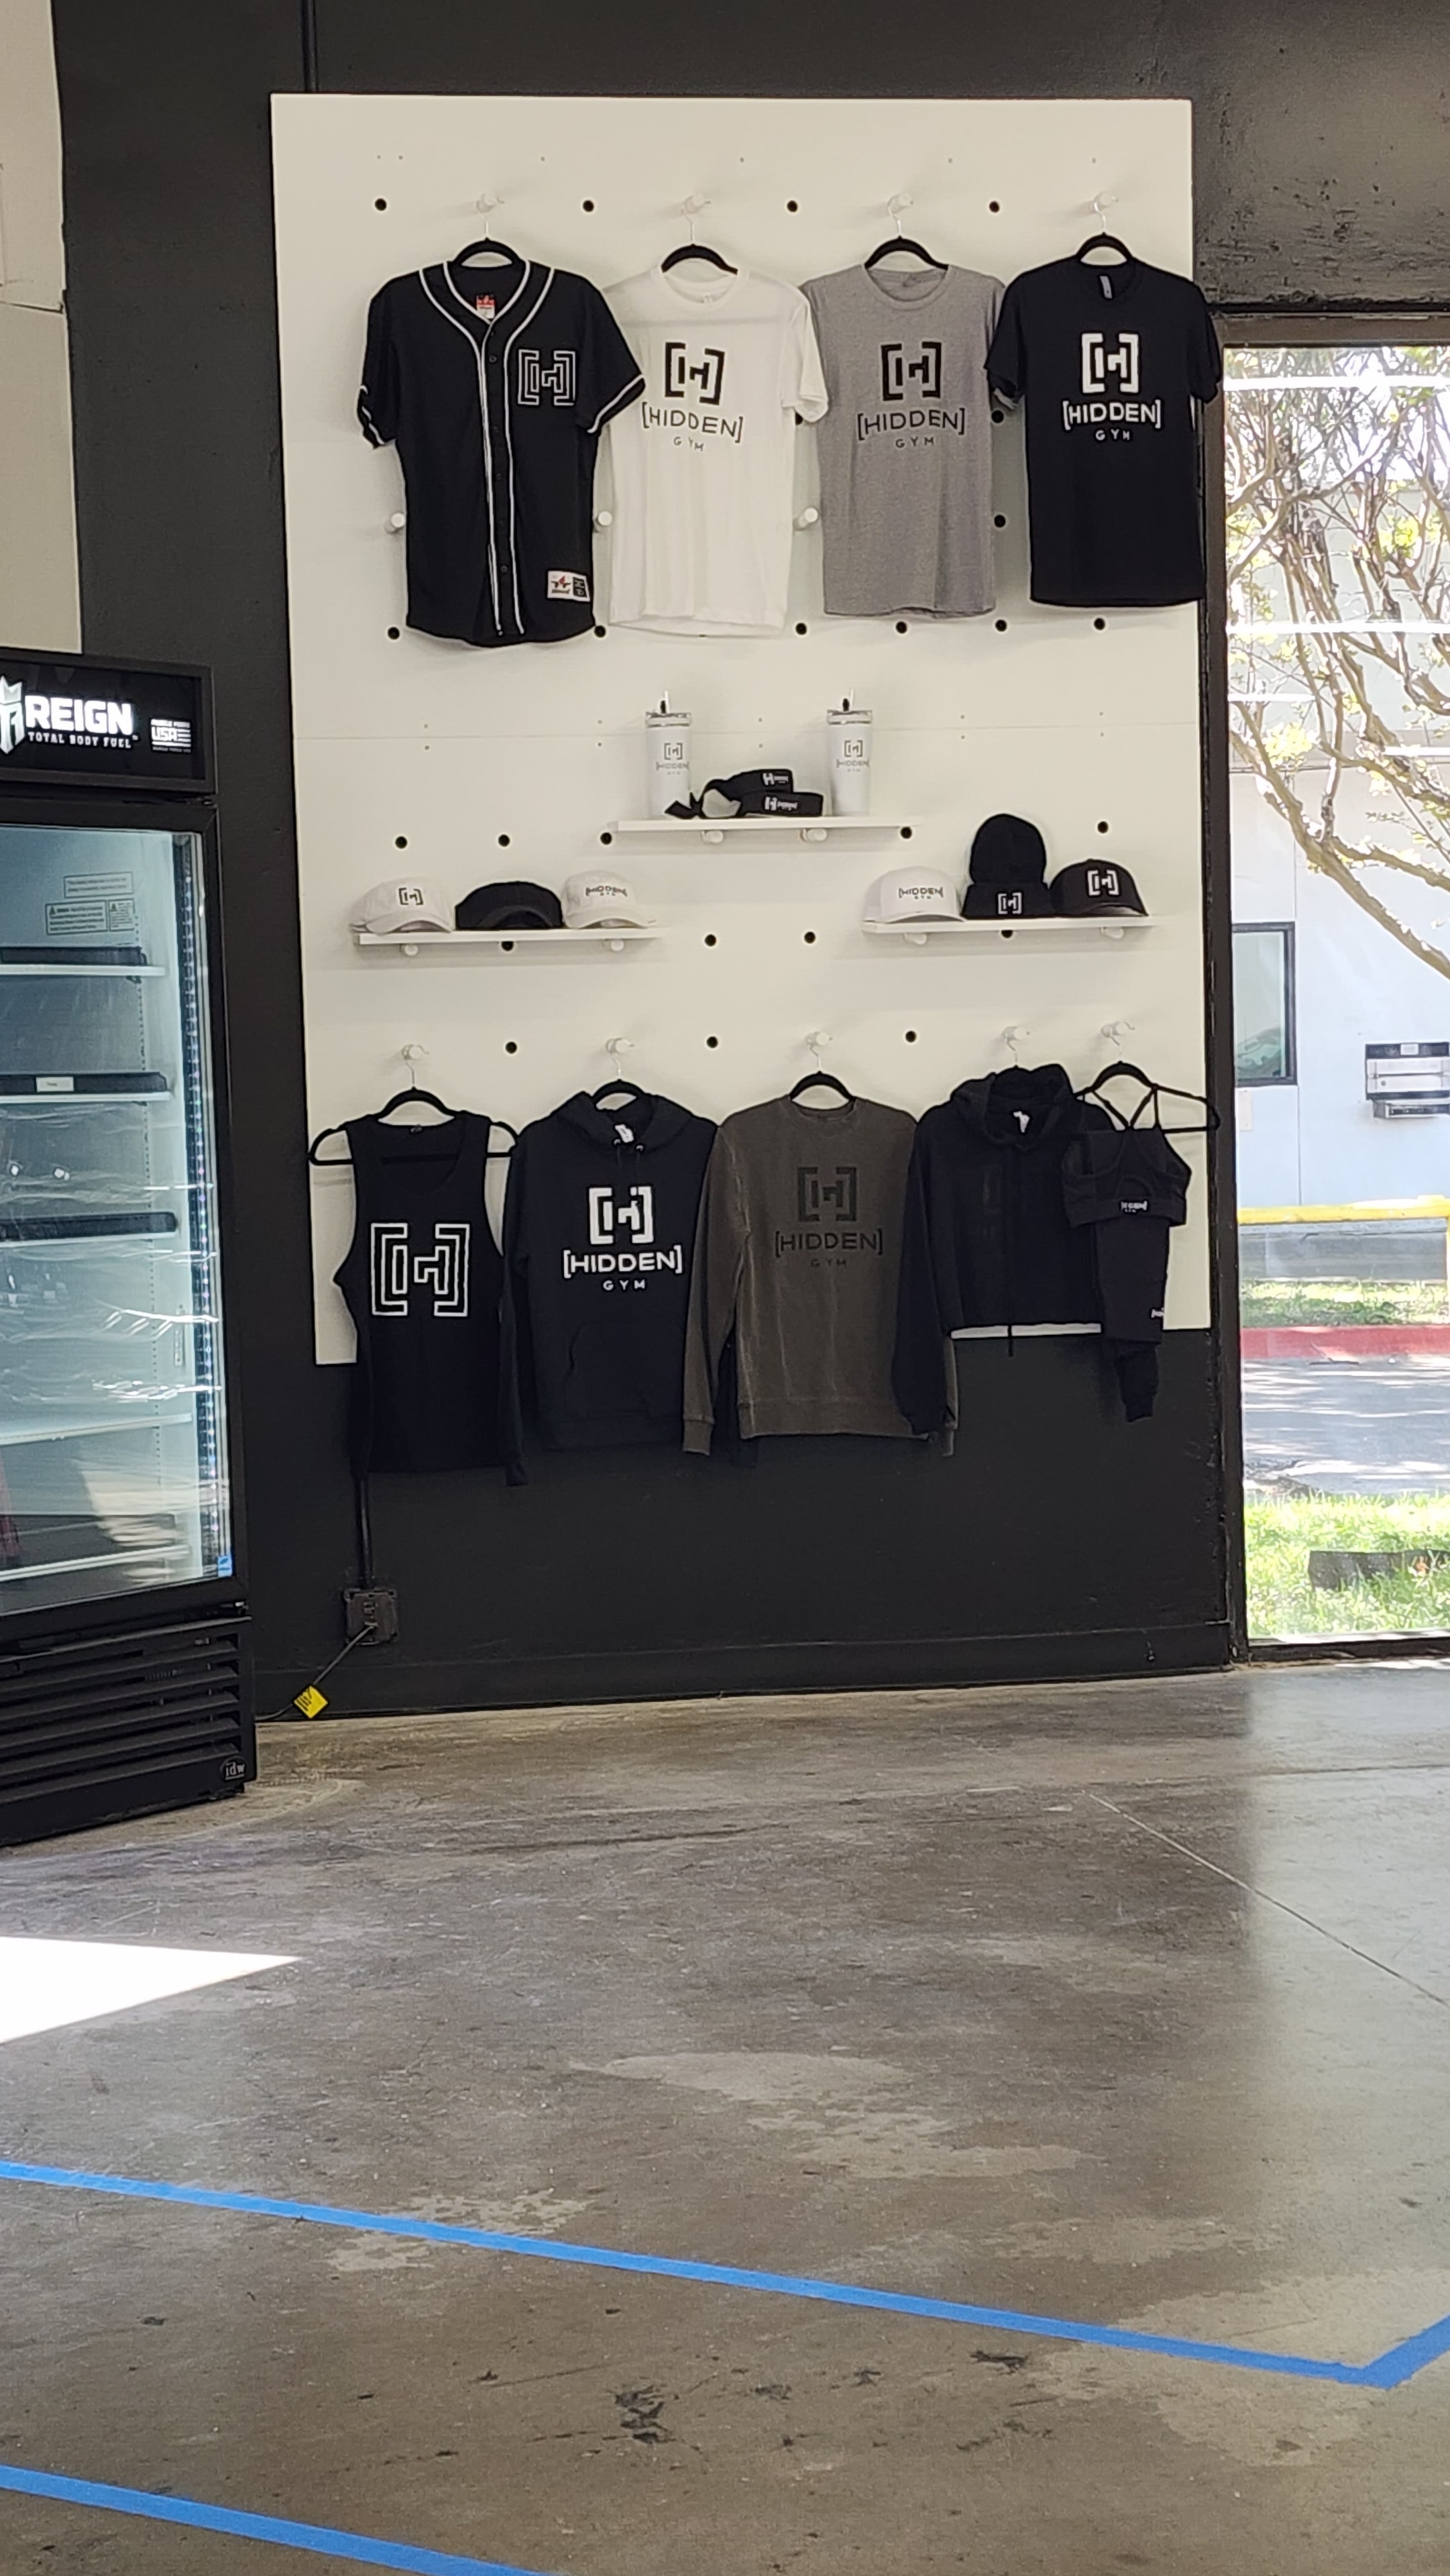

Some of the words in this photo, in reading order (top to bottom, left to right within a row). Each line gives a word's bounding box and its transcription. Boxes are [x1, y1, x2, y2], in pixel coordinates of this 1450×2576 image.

[1095, 429, 1130, 441] GYM
[673, 436, 705, 451] GYM
[895, 436, 935, 449] GYM
[25, 695, 133, 735] REIGN
[28, 732, 65, 744] TOTAL
[69, 735, 99, 746] BODY
[103, 737, 132, 749] FUEL
[151, 727, 178, 742] USA
[810, 1258, 848, 1268] GYM
[602, 1279, 647, 1291] GYM
